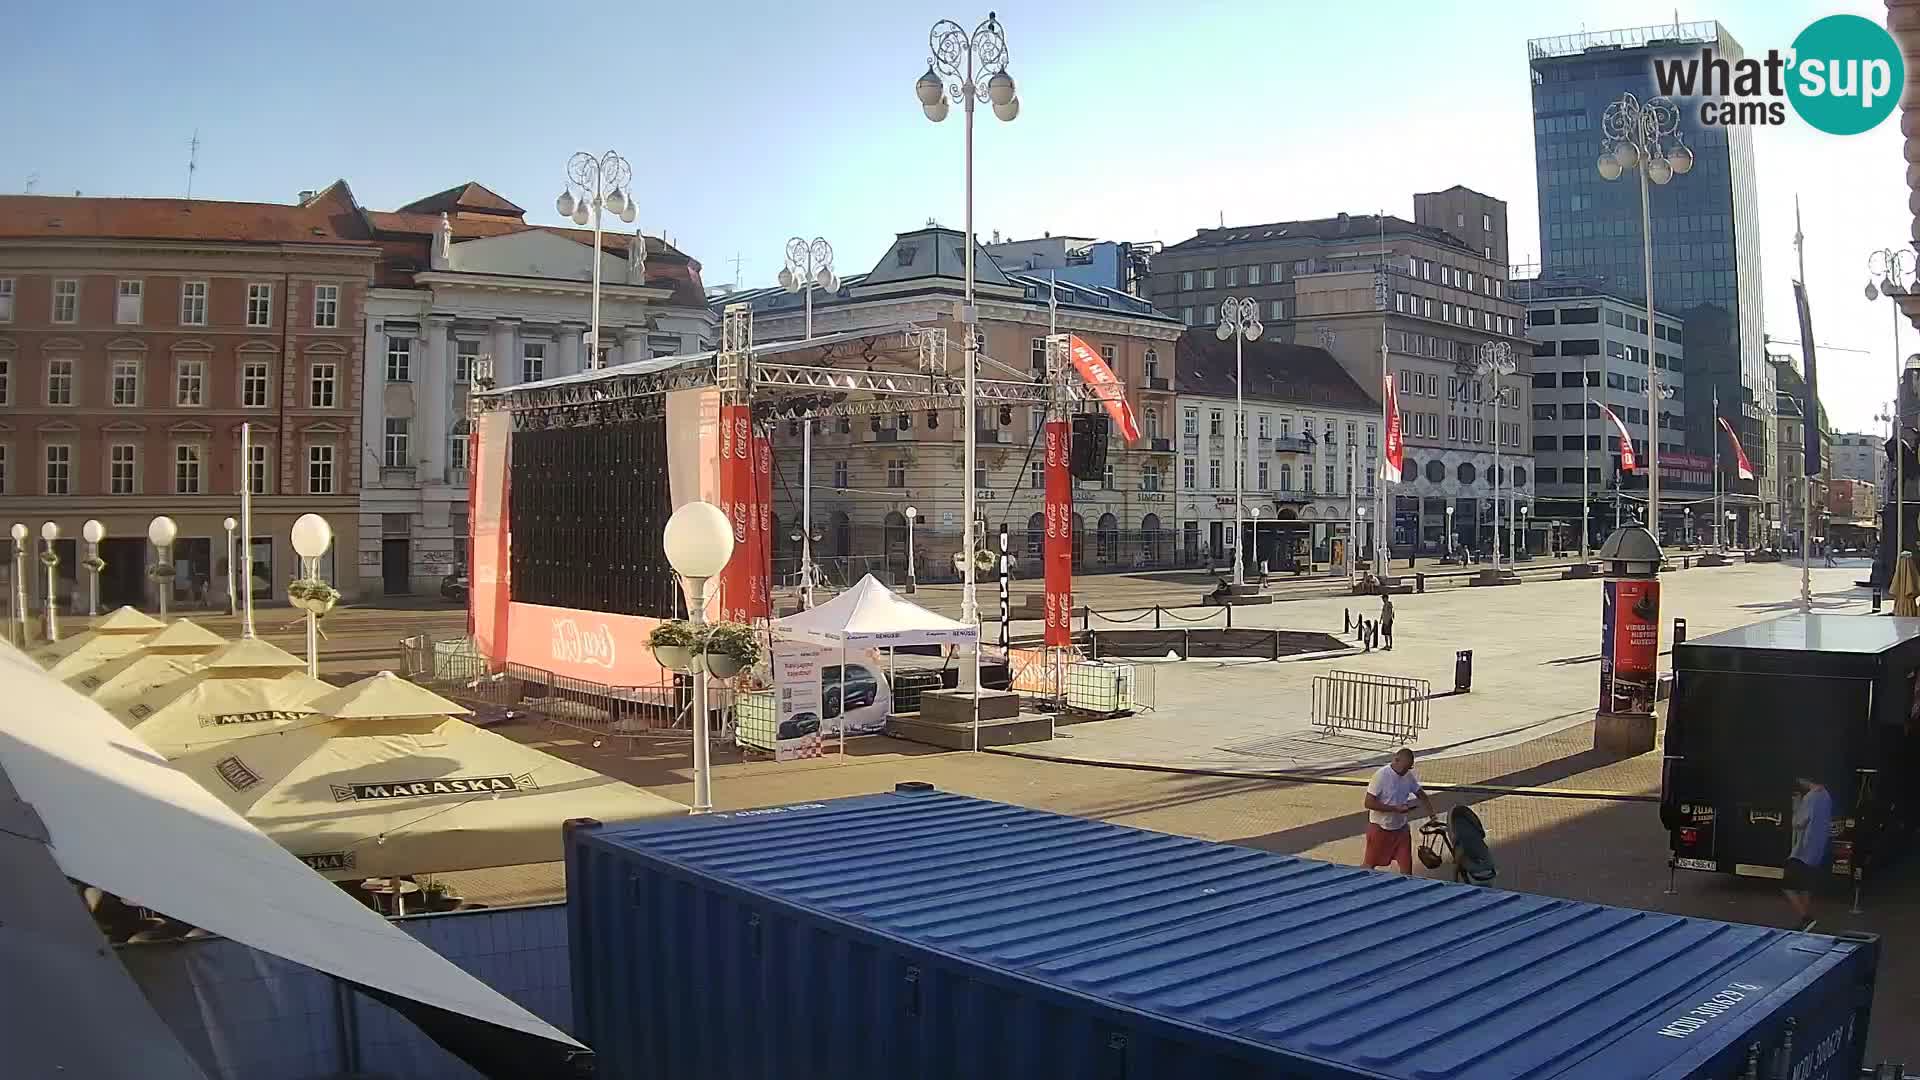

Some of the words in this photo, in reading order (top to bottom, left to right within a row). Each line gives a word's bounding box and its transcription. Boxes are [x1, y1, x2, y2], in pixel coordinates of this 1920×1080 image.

[1137, 493, 1166, 502] SINGER
[364, 778, 509, 798] MARASKA
[1690, 990, 1745, 1018] 300629
